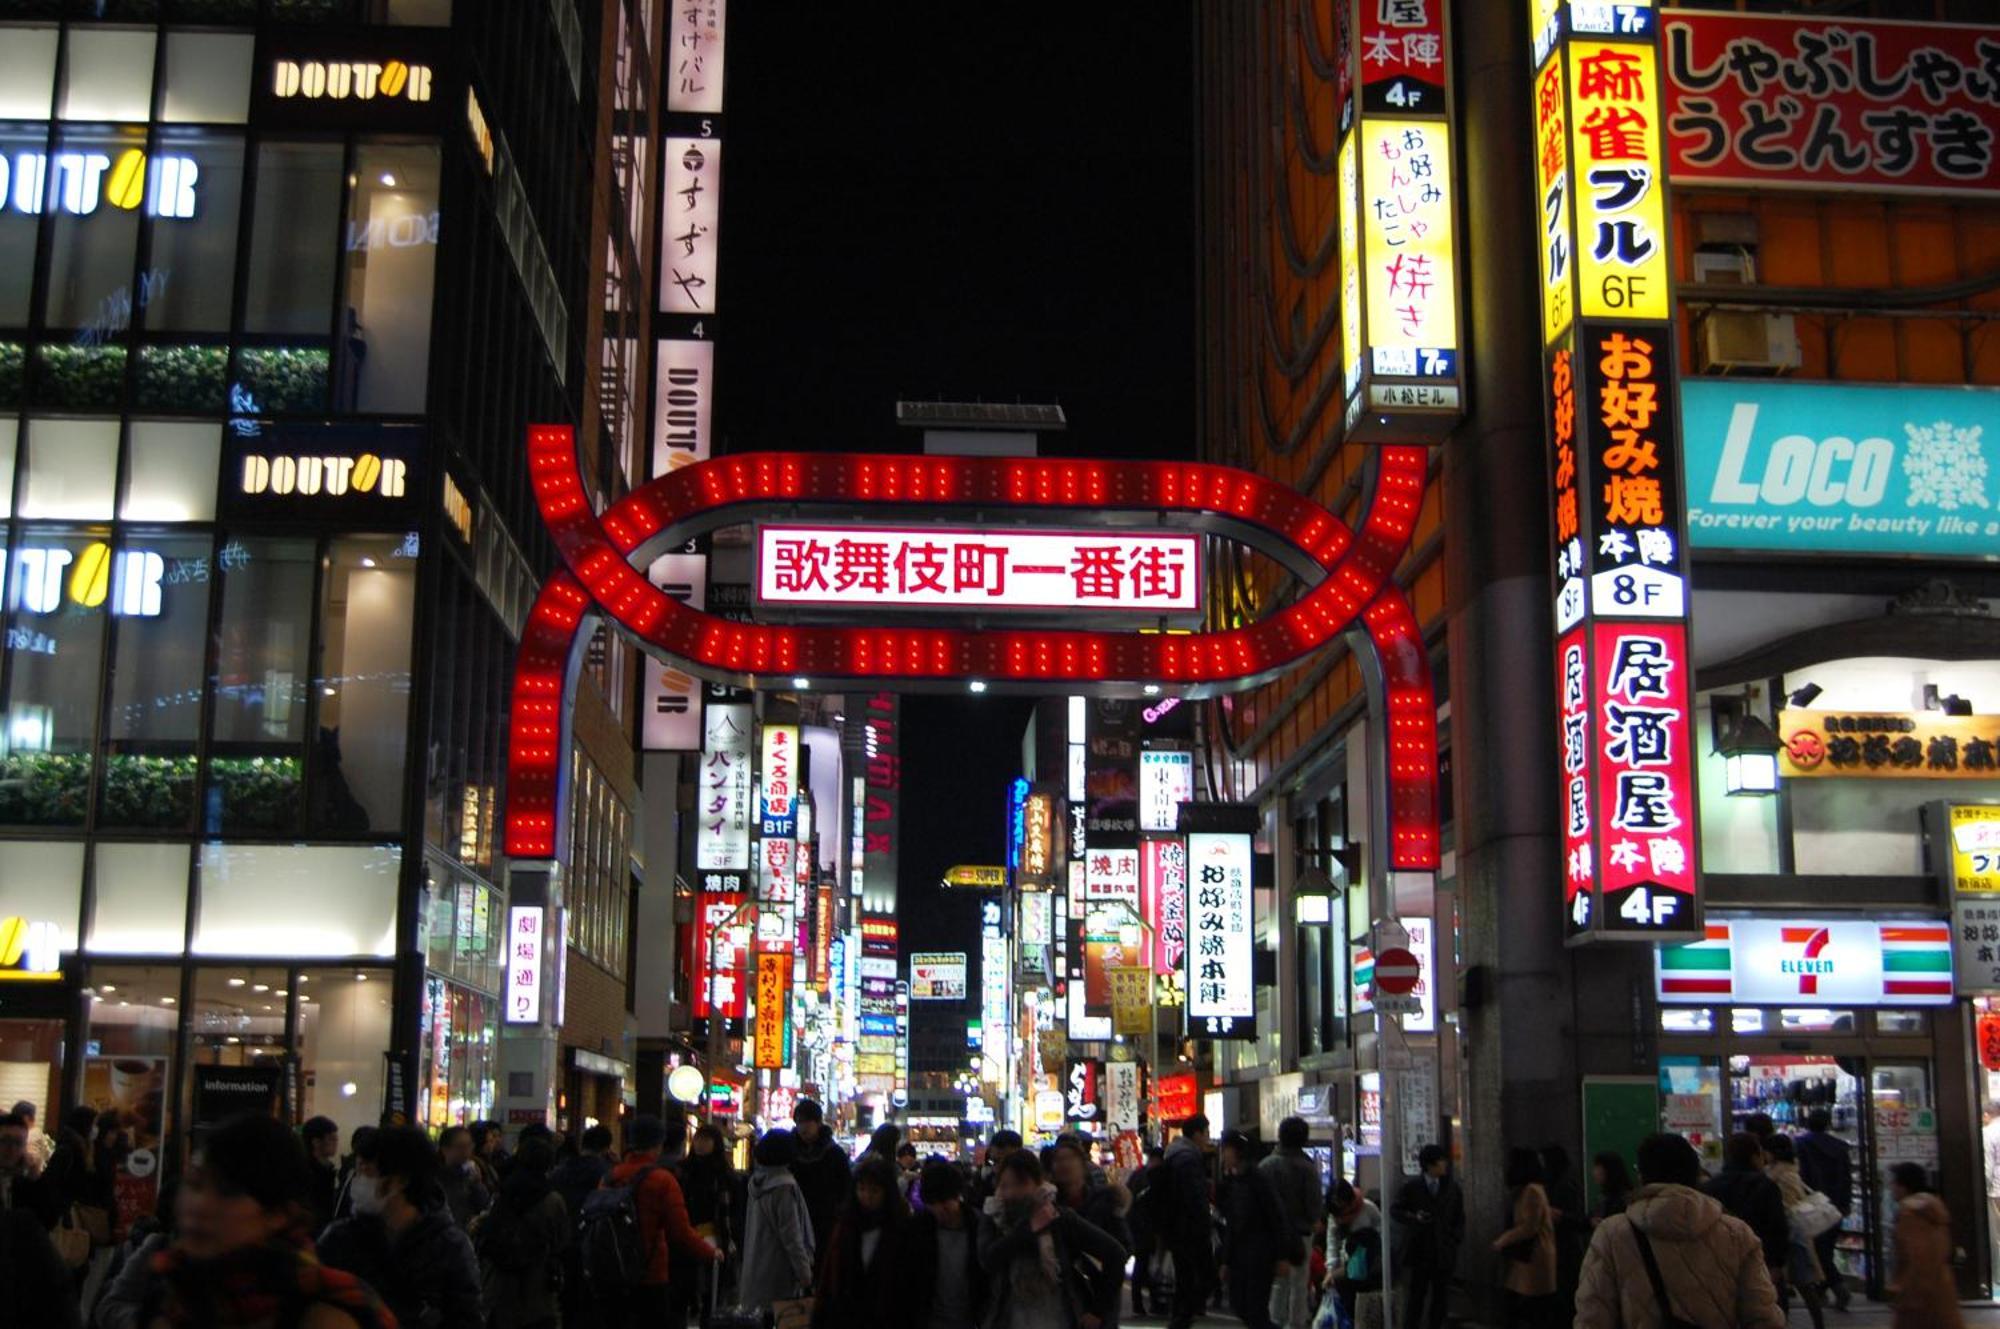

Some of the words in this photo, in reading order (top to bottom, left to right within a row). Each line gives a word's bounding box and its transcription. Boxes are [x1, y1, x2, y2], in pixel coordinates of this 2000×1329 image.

[1616, 6, 1645, 32] 7F
[1362, 31, 1441, 68] 本陣
[275, 61, 432, 101] DOUTOR
[1385, 82, 1422, 107] 4F
[701, 119, 712, 138] 5
[1670, 98, 1992, 177] うどんすき
[1402, 129, 1442, 203] お好み
[1602, 275, 1647, 308] 6F
[692, 321, 704, 339] 4
[1420, 349, 1448, 375] 7F
[1383, 387, 1445, 405] 小松ビル
[666, 368, 699, 471] DOUTO
[1600, 332, 1663, 525] お好み焼
[243, 454, 406, 497] DOUTOR
[1688, 509, 1782, 529] Forever
[1787, 515, 1843, 532] your
[1849, 514, 1930, 536] beauty
[1936, 515, 1979, 535] like
[774, 538, 1185, 599] 歌舞伎町一番街
[1613, 574, 1663, 606] 8F
[1608, 637, 1679, 830] 居酒屋
[707, 751, 731, 836] バンタイ
[763, 820, 793, 834] B1F
[1091, 854, 1136, 877] 焼肉
[704, 874, 740, 892] 焼肉
[1619, 887, 1678, 924] 4F
[515, 916, 537, 1012] 劇場通り
[1206, 1016, 1234, 1034] 2F
